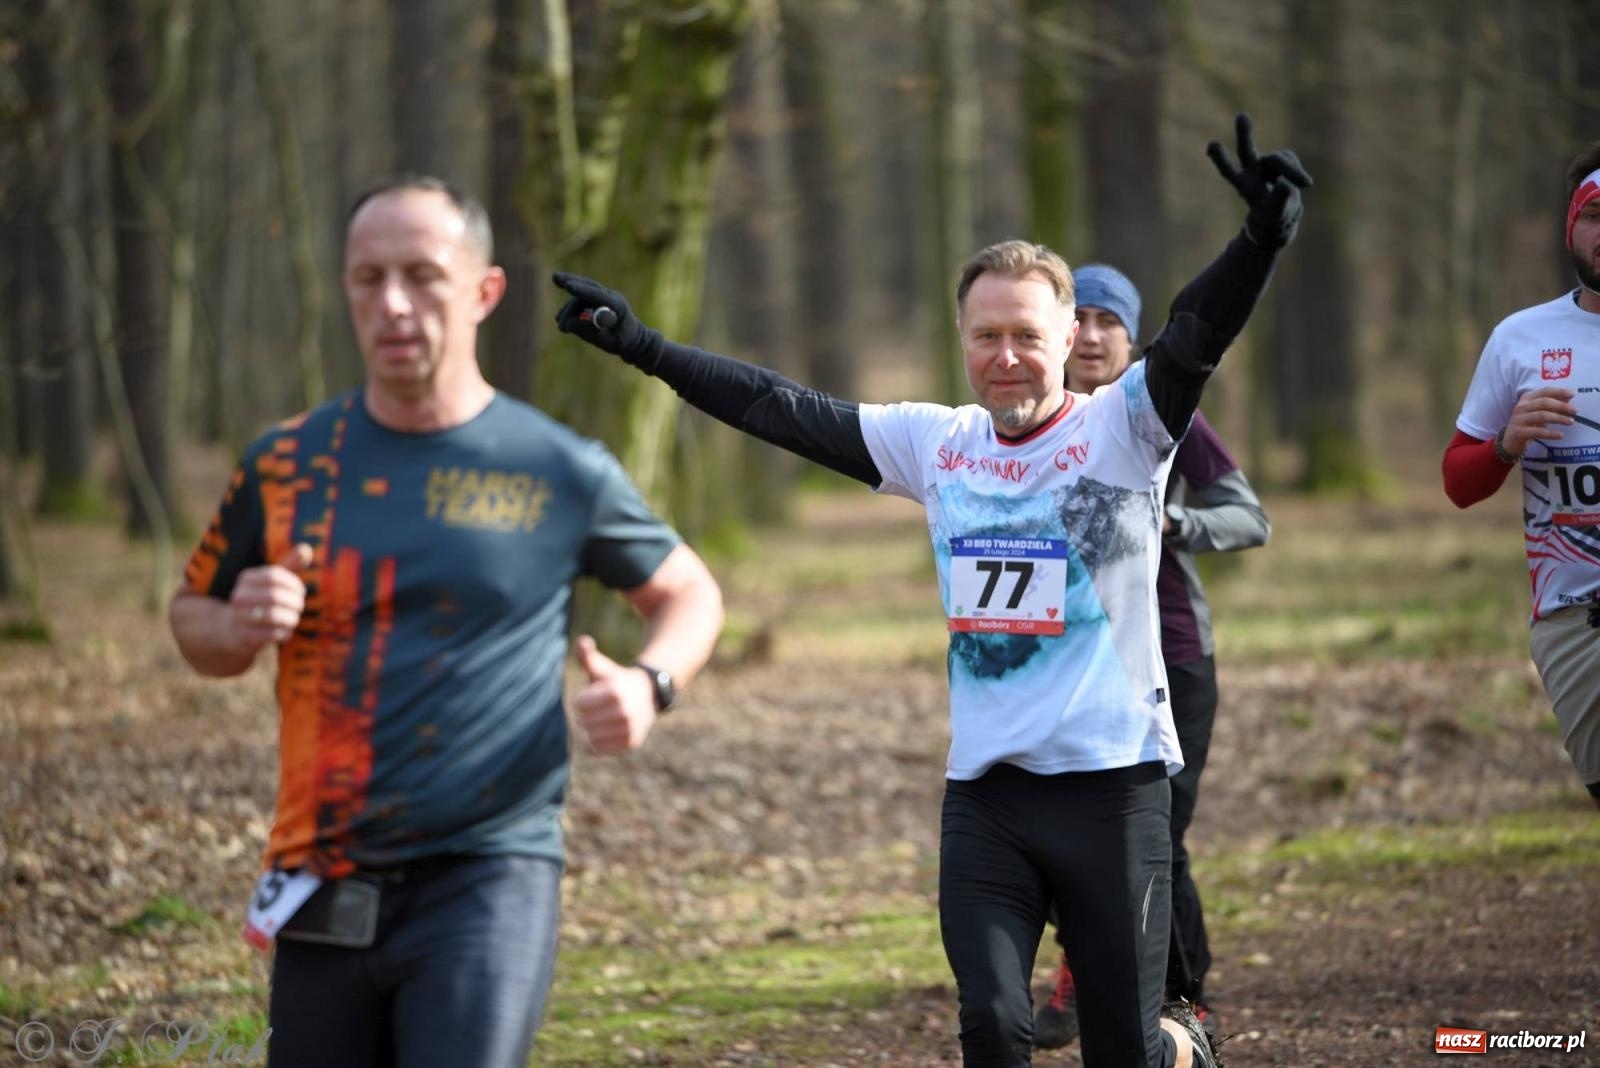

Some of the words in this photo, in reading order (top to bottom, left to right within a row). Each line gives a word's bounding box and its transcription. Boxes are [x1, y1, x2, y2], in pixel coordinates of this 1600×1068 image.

[974, 539, 992, 549] BIEG
[993, 538, 1053, 551] TWARDZIELA
[976, 560, 1035, 610] 77
